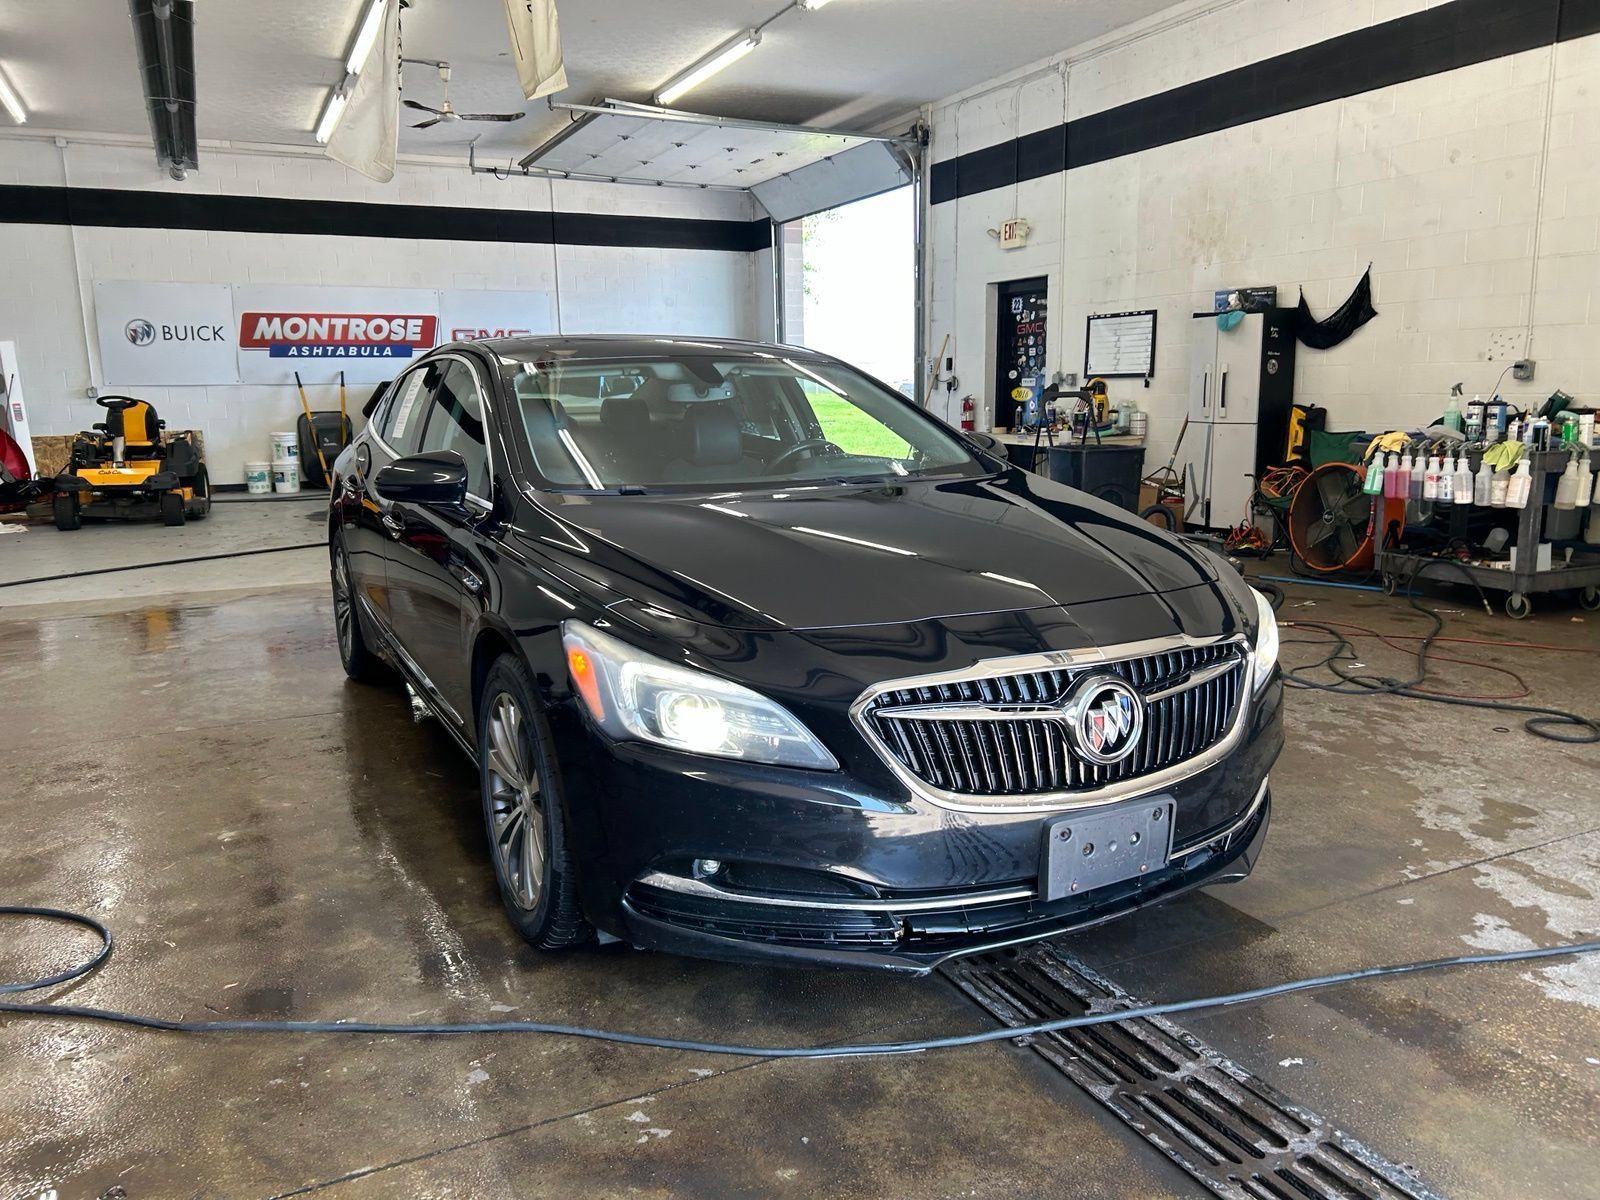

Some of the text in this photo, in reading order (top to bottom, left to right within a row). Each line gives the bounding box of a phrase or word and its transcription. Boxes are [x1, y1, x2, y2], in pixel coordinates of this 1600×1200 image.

[1004, 222, 1017, 240] EXIT
[1013, 299, 1021, 311] 22
[162, 325, 225, 341] BUICK
[253, 316, 423, 341] MONTROSE
[1017, 322, 1043, 335] GMC
[288, 346, 393, 356] ASHTABULA
[1014, 390, 1029, 399] 2016
